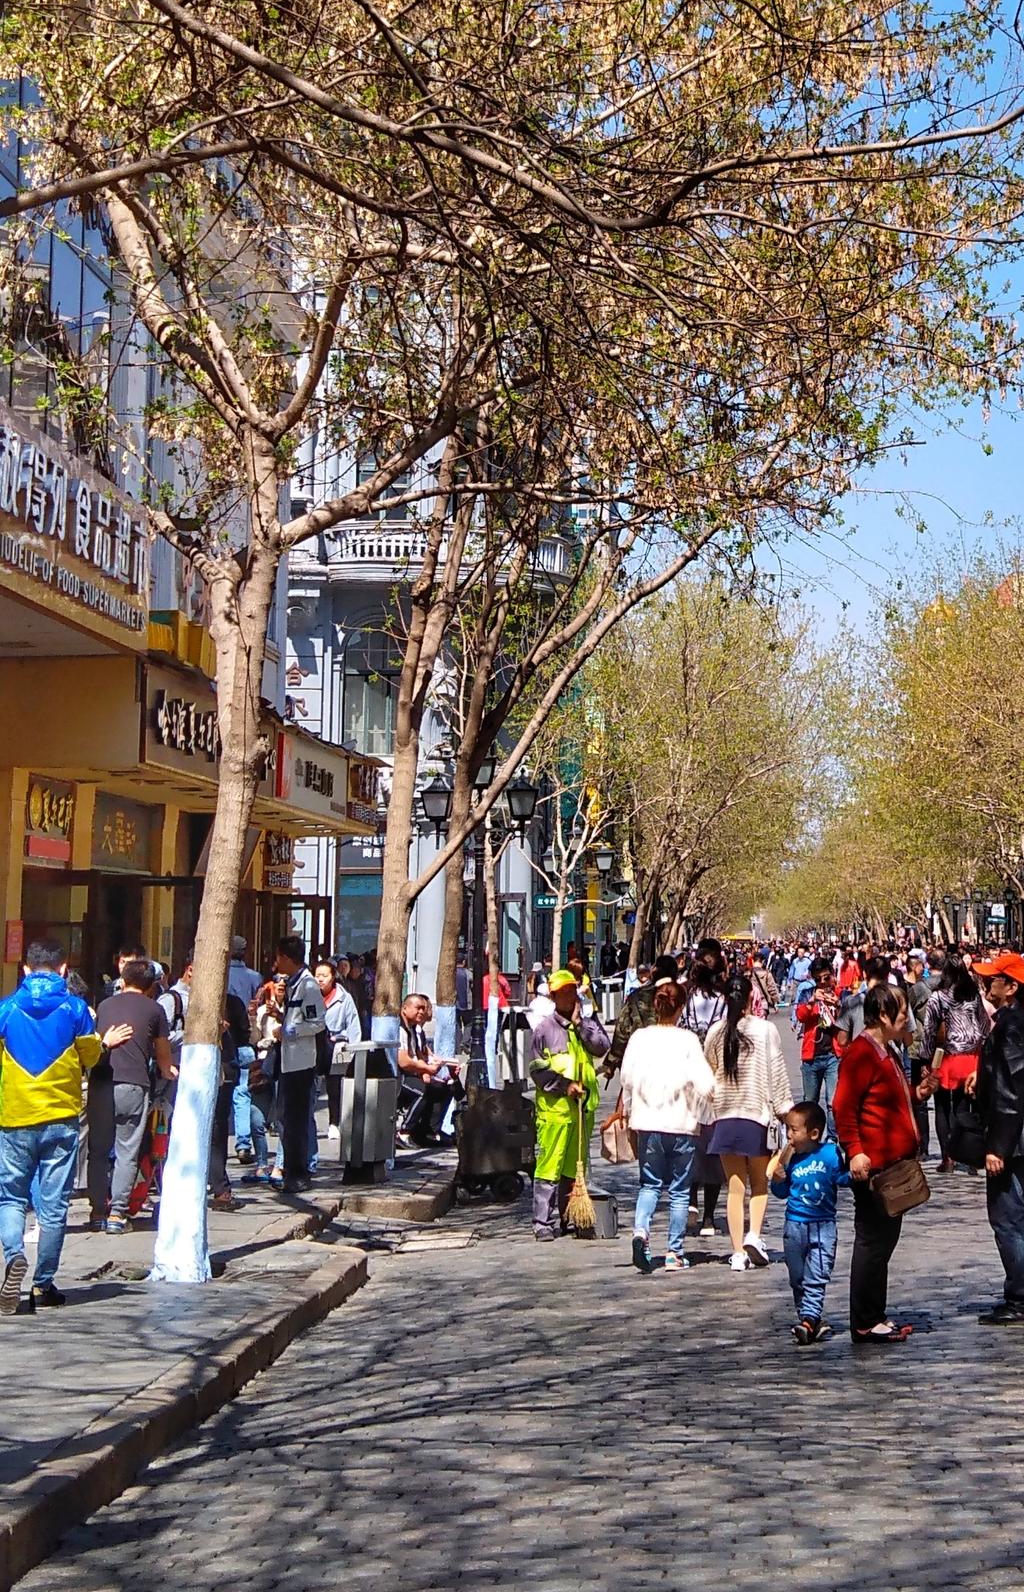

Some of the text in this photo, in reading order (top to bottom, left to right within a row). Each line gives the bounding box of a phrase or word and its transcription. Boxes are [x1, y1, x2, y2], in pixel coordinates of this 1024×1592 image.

[42, 562, 54, 585] OF
[57, 567, 80, 598] FOOD
[82, 581, 146, 632] SUPERMARKETS
